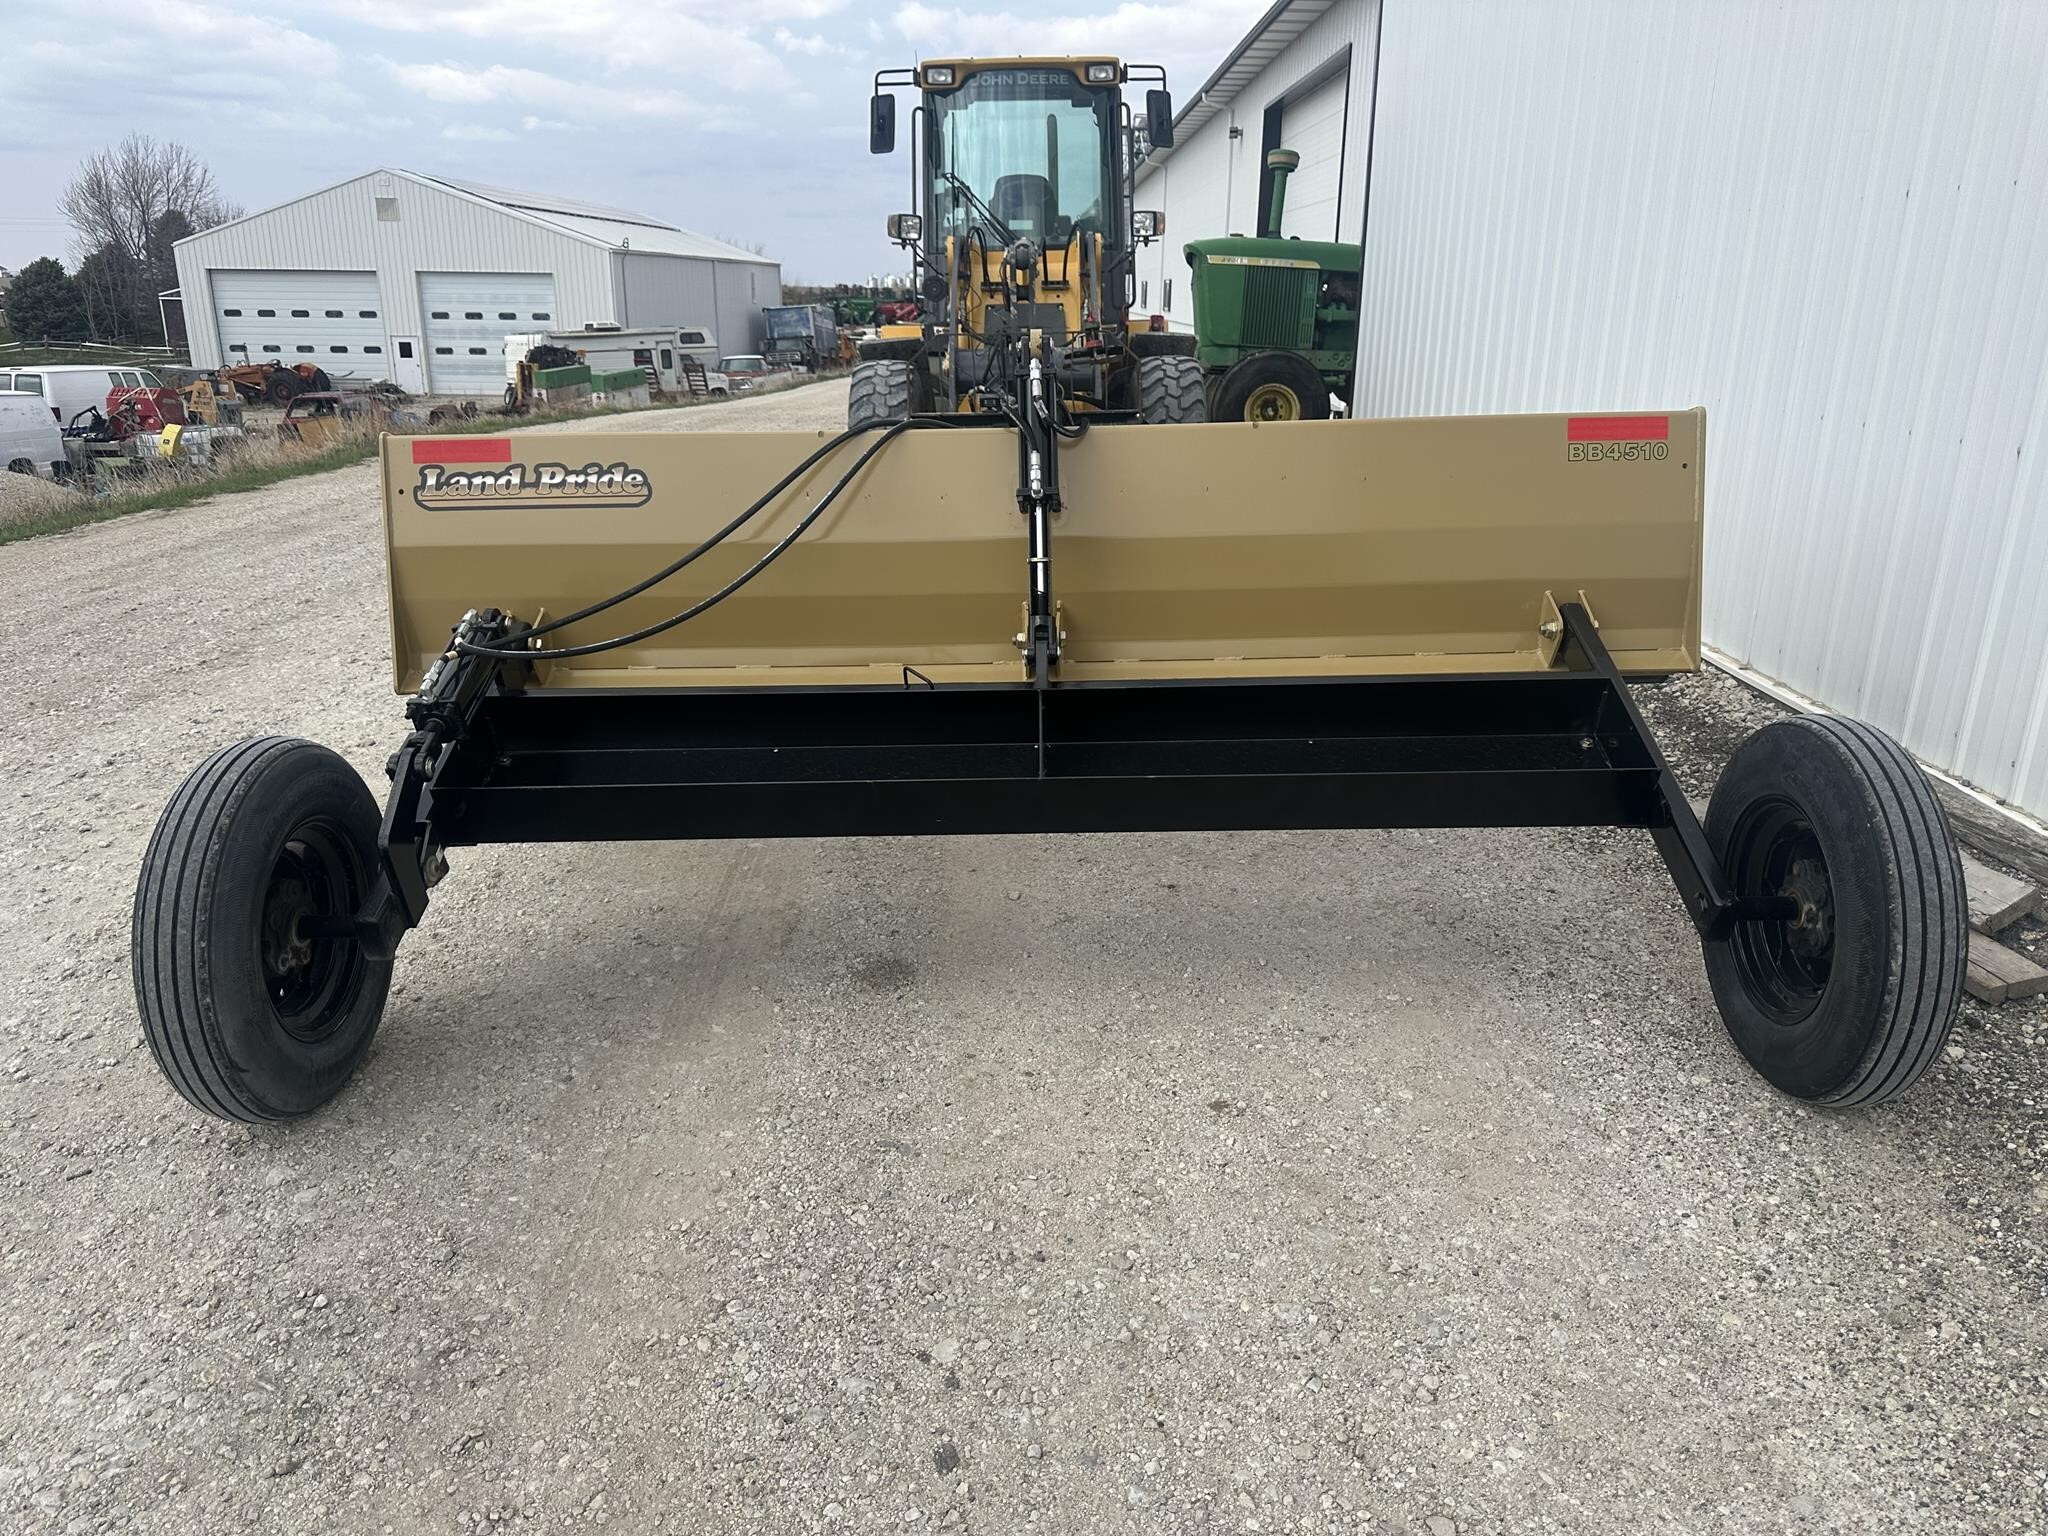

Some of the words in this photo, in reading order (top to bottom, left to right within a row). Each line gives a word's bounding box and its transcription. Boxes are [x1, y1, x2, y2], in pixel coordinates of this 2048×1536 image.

[972, 73, 1013, 86] JOHN
[1017, 73, 1069, 85] DEERE
[1567, 441, 1669, 462] BB4510
[421, 465, 523, 497] Land
[535, 464, 645, 496] Pride
